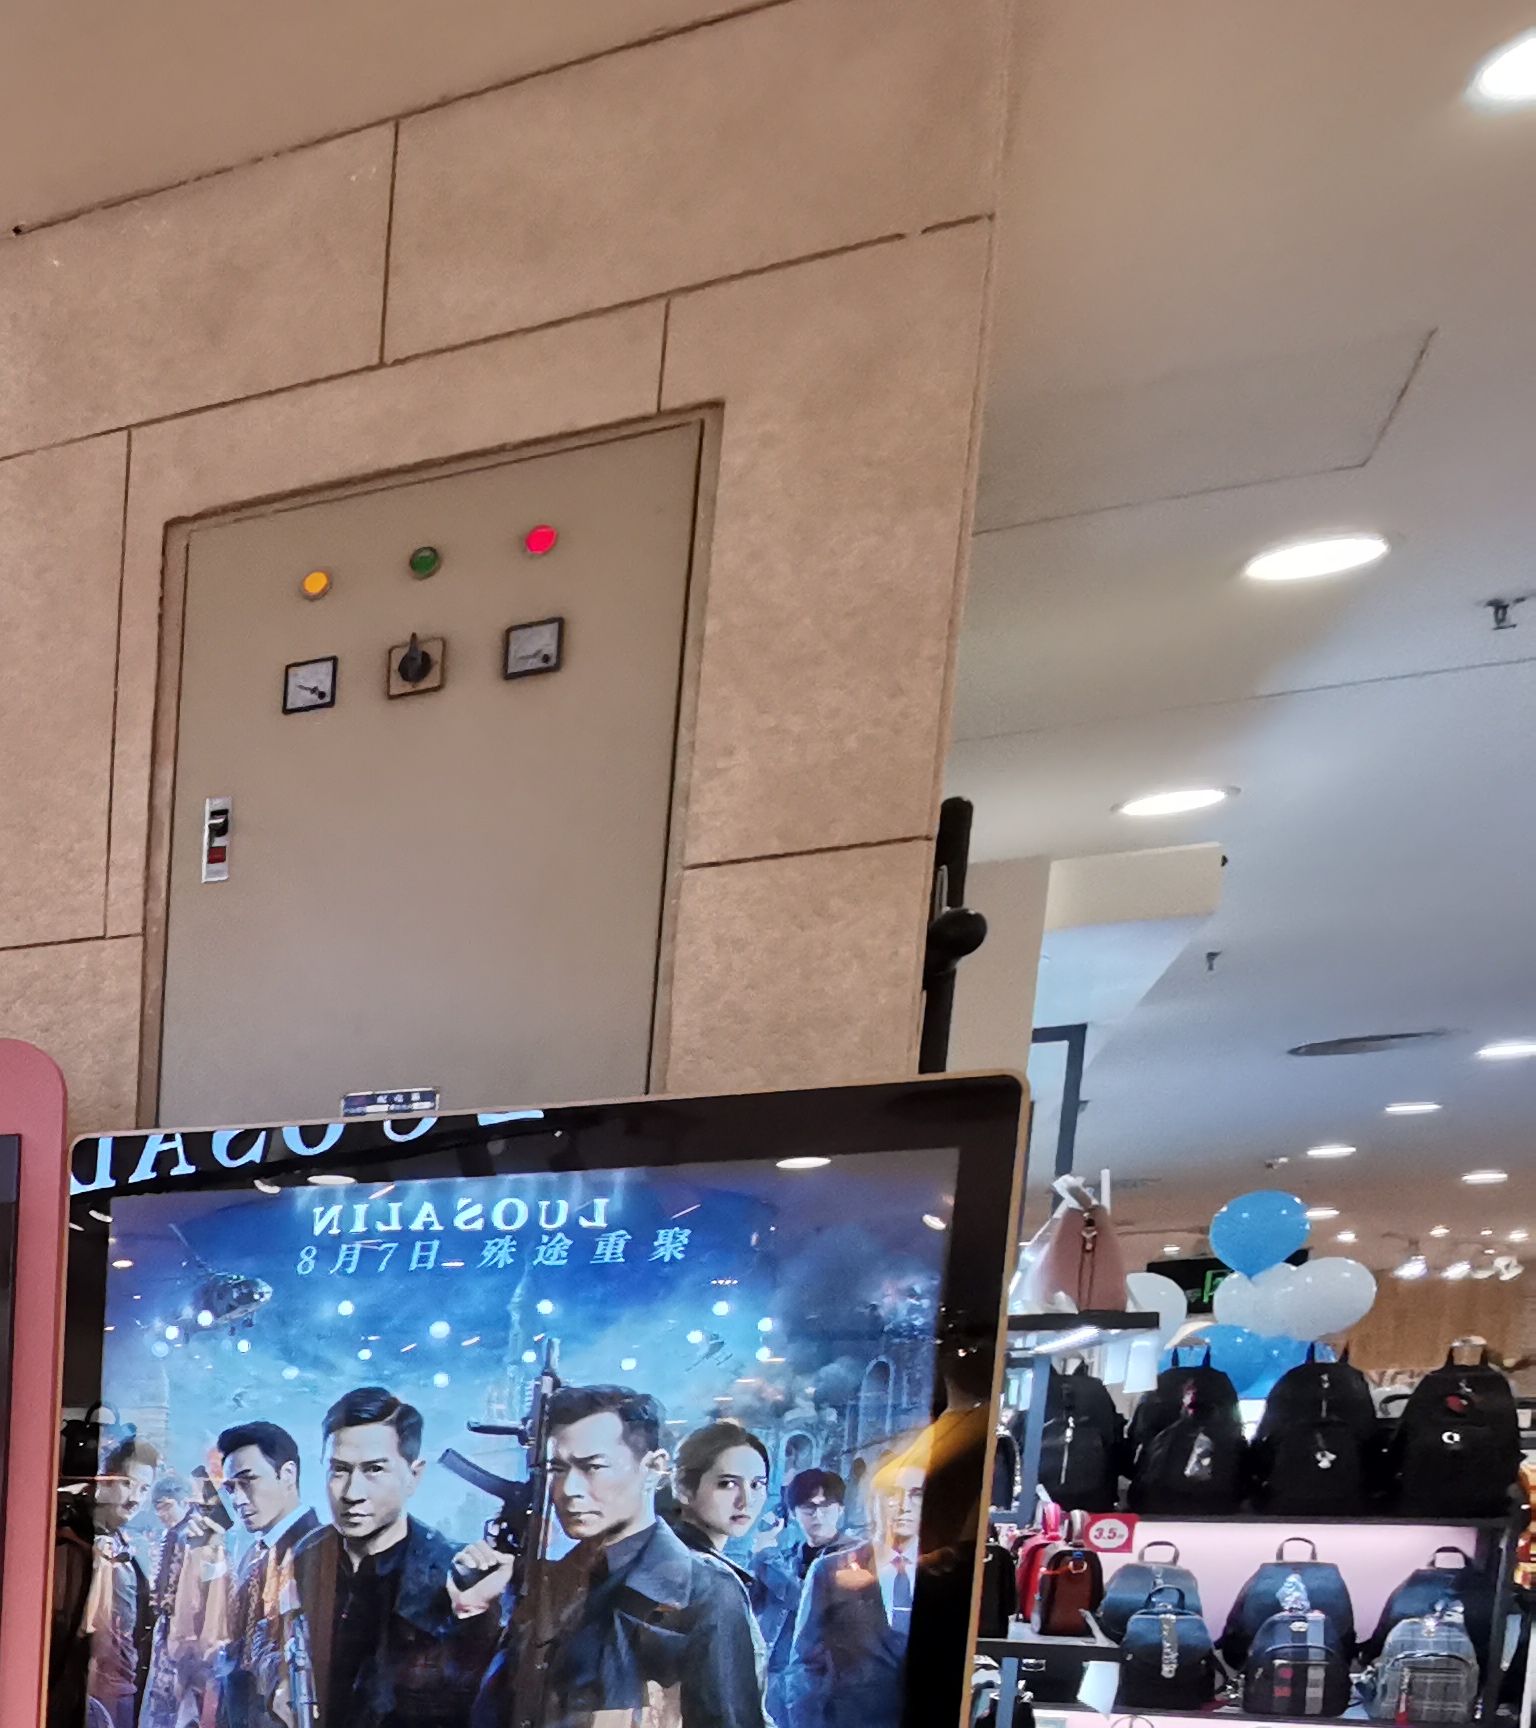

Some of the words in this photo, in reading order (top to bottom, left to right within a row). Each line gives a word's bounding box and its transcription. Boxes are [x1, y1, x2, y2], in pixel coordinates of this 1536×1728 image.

[296, 1238, 442, 1276] 8月7日
[476, 1226, 692, 1269] 殊途重聚
